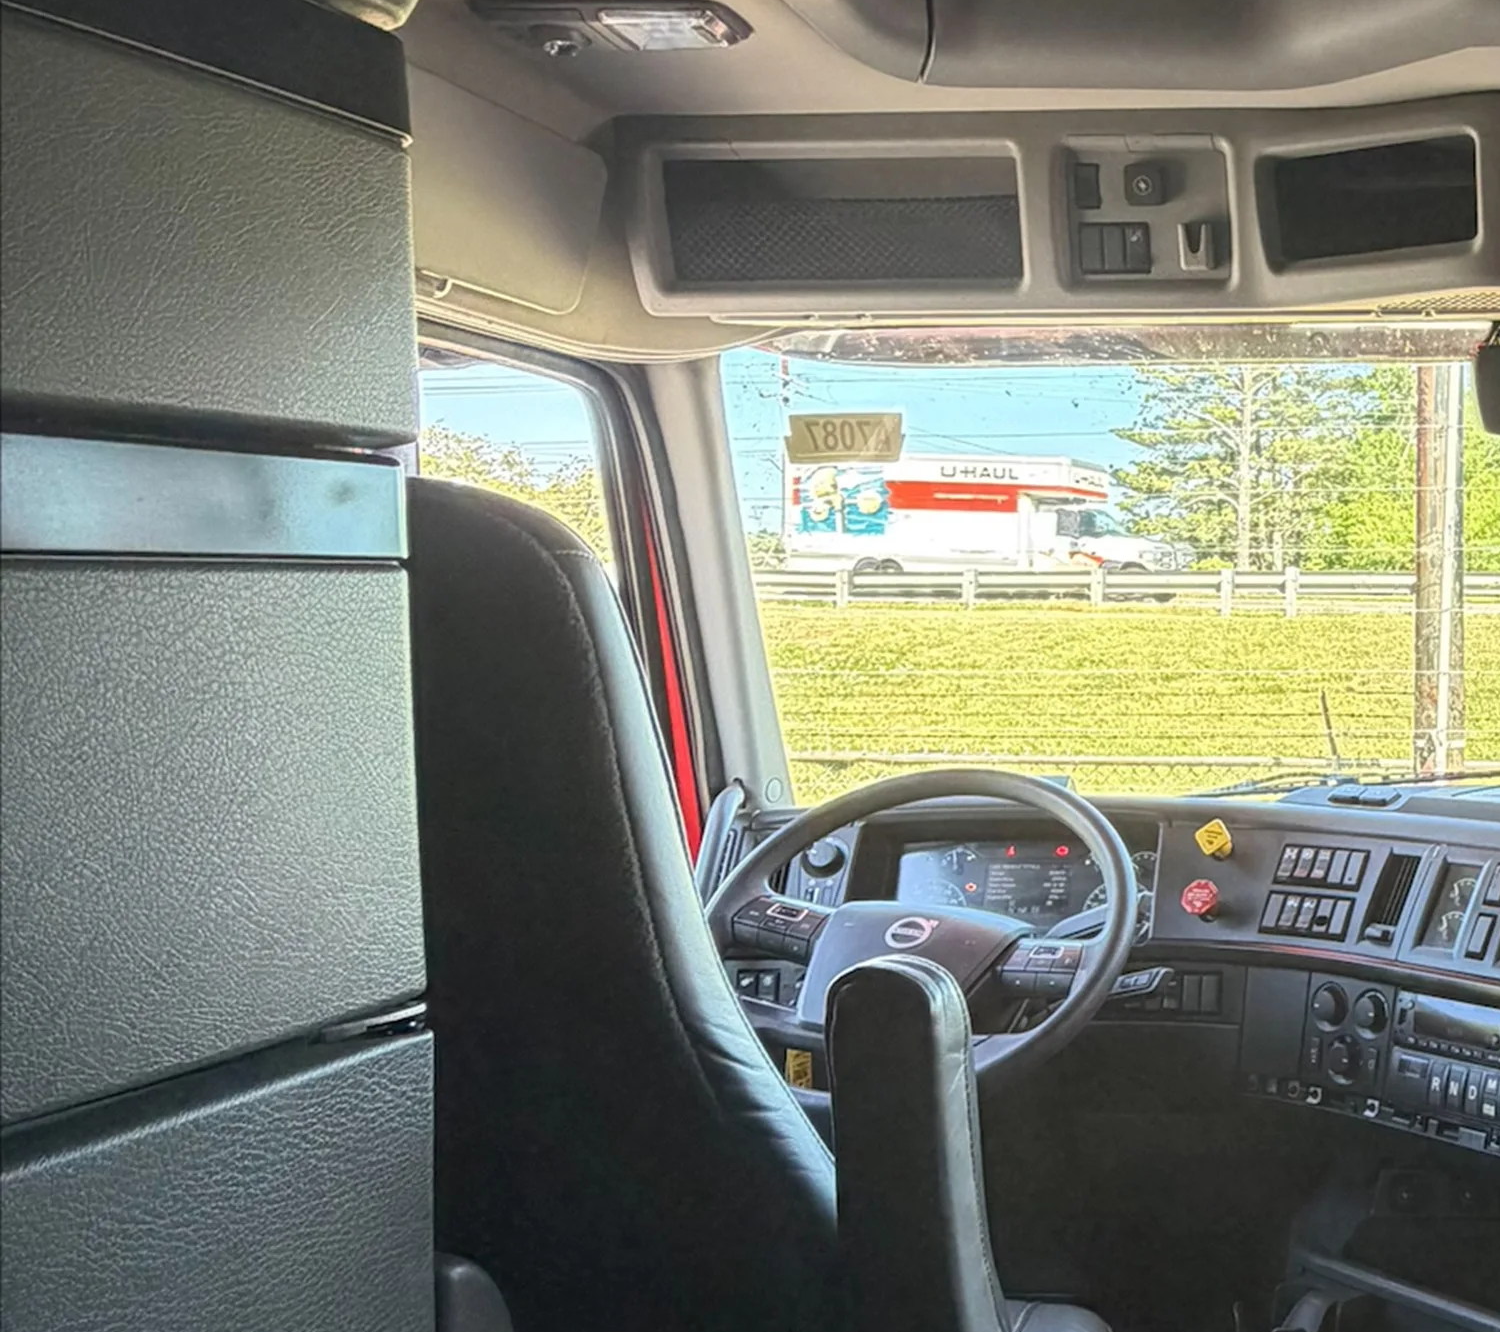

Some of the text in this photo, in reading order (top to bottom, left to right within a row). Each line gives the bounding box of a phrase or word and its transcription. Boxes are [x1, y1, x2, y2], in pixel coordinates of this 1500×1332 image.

[1431, 1077, 1441, 1092] R
[1449, 1081, 1459, 1096] N
[1468, 1085, 1477, 1100] D
